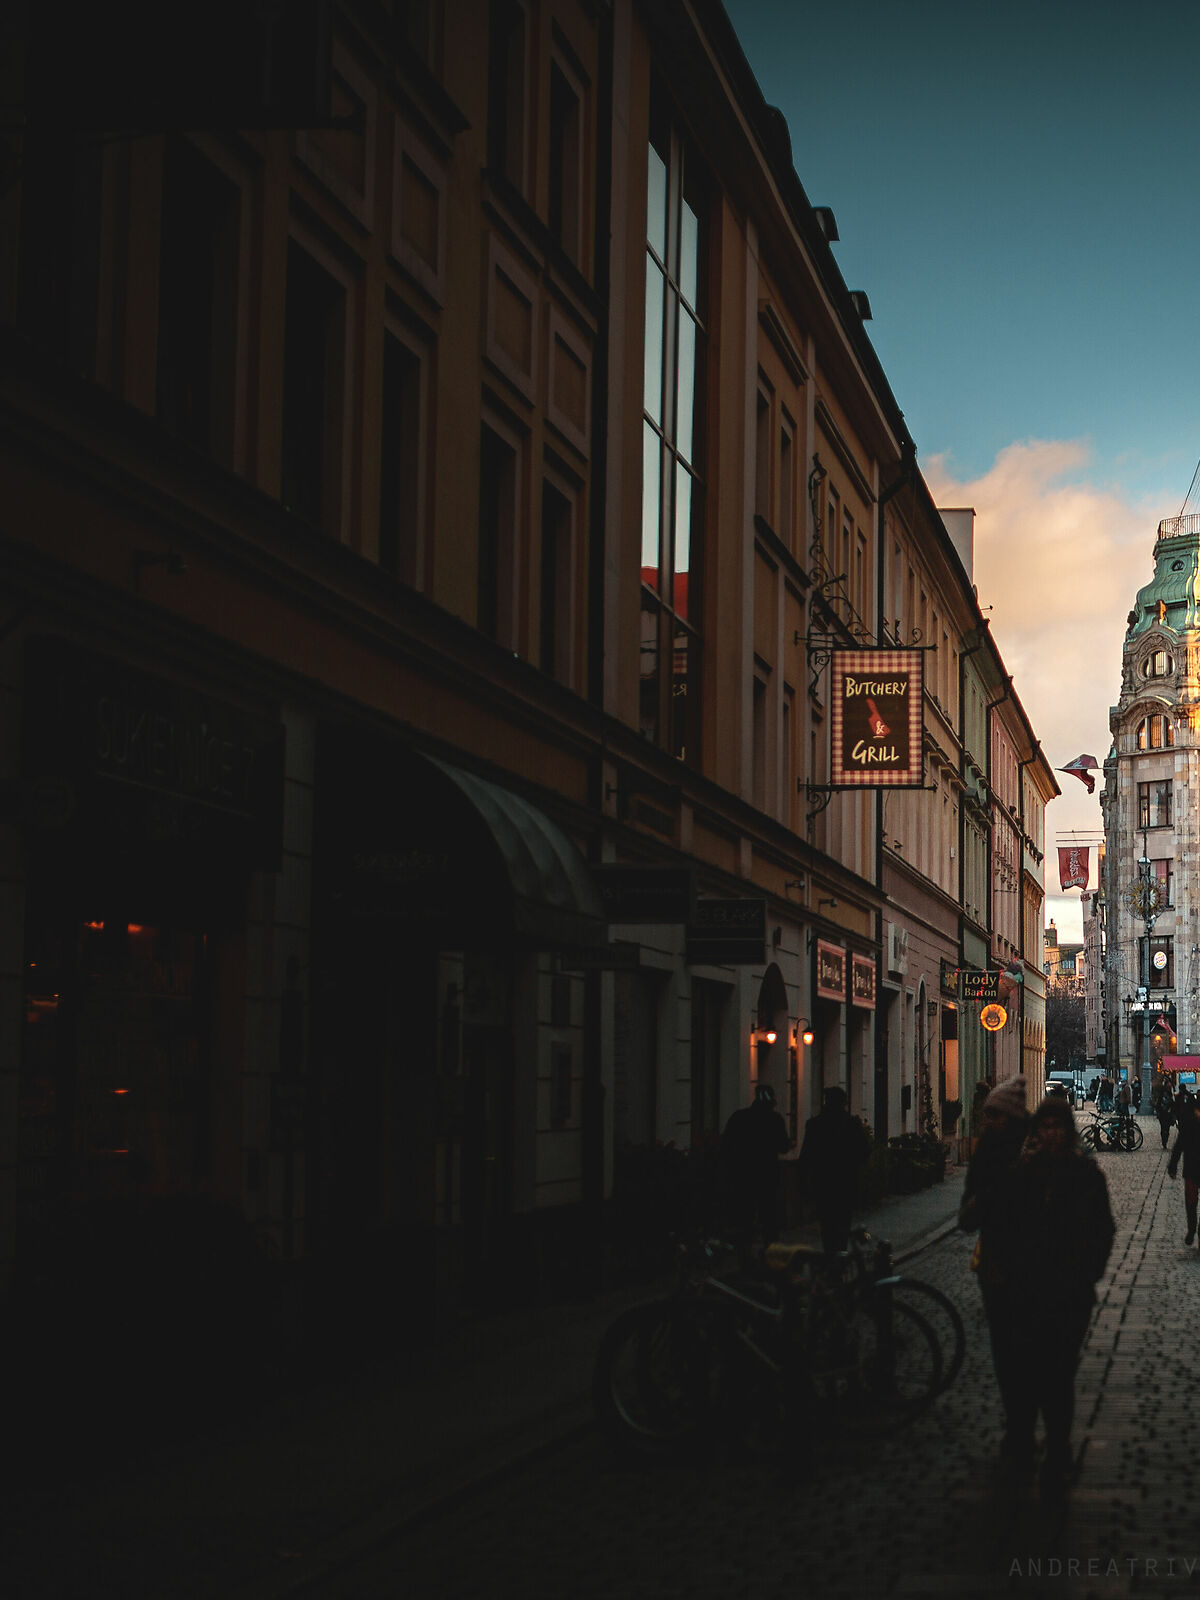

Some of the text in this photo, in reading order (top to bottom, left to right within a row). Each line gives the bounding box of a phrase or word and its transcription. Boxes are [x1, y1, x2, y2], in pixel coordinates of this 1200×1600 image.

[845, 677, 907, 698] BUTCHERY
[851, 739, 900, 764] GRILL
[965, 973, 997, 988] Lody
